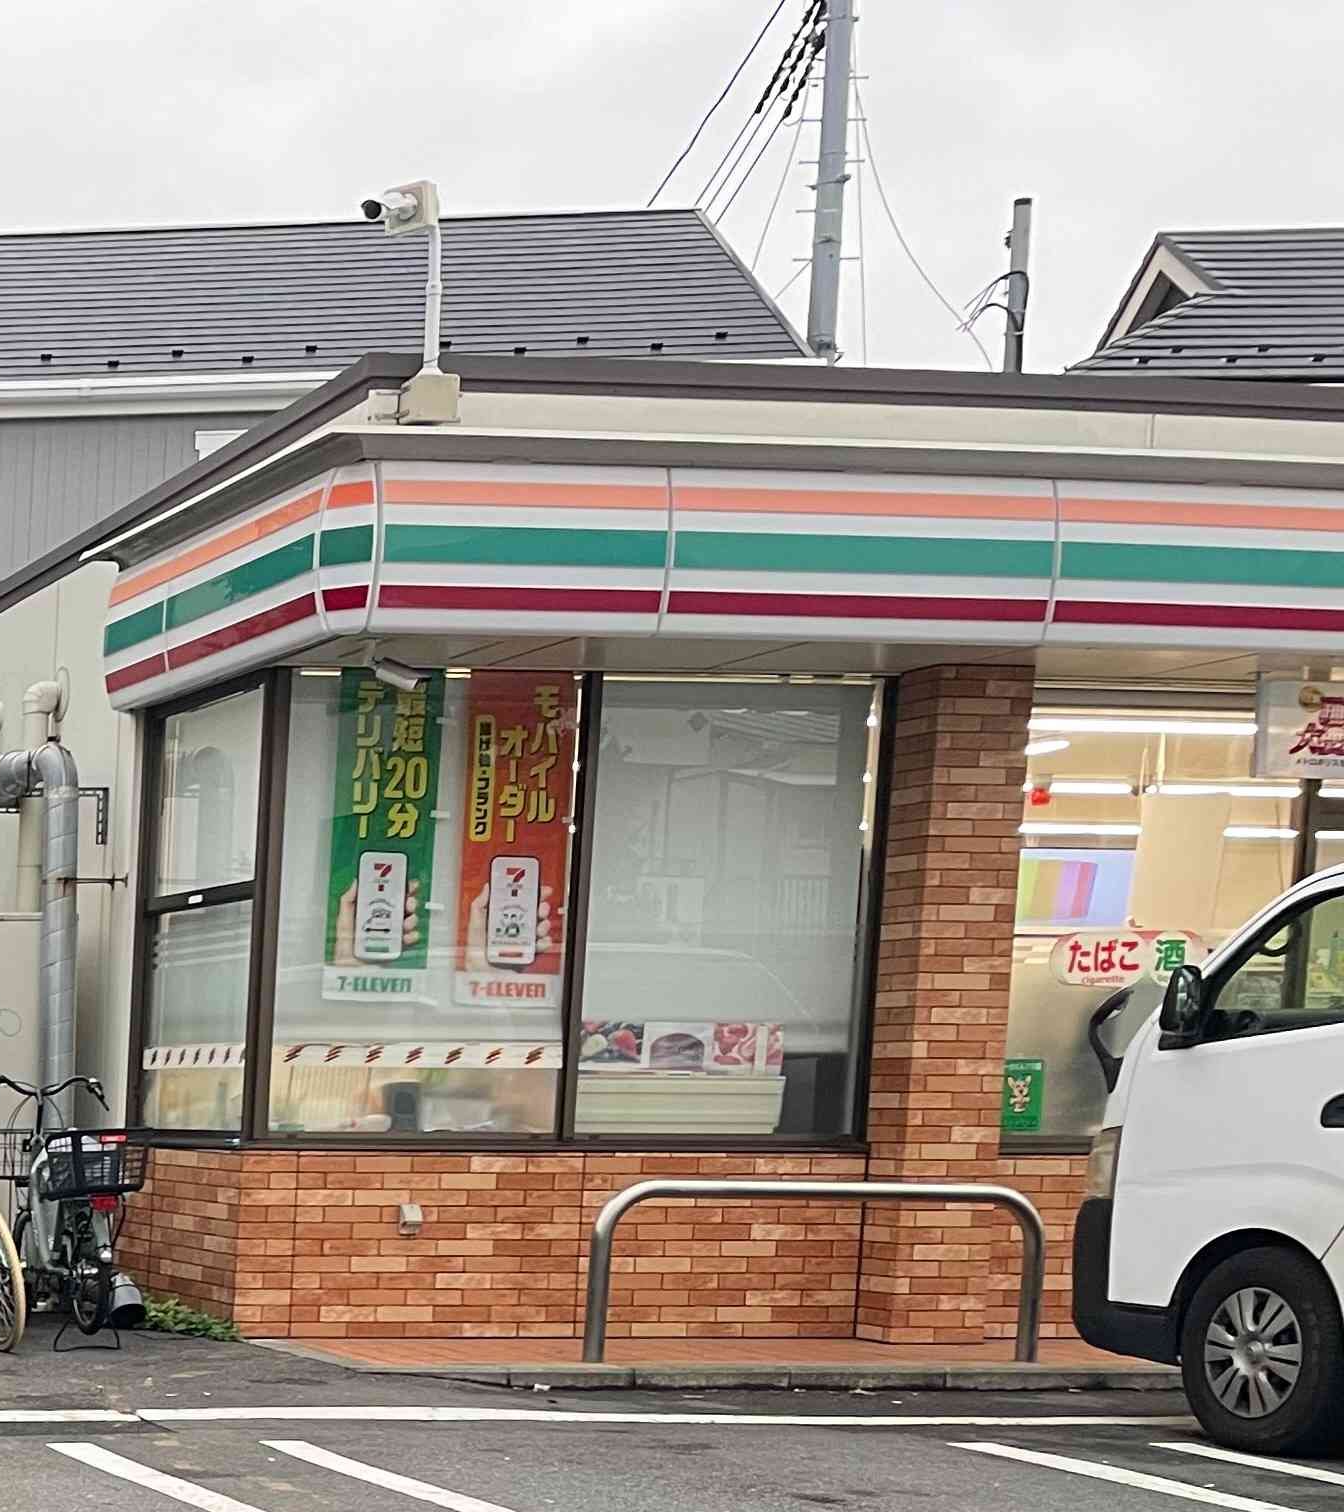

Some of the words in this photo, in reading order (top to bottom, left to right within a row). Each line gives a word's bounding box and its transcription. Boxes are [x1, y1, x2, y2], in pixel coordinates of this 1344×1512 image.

[499, 725, 528, 842] オーダー
[527, 686, 560, 823] モバイル
[1068, 939, 1139, 973] たばこ
[1155, 939, 1186, 971] 酒
